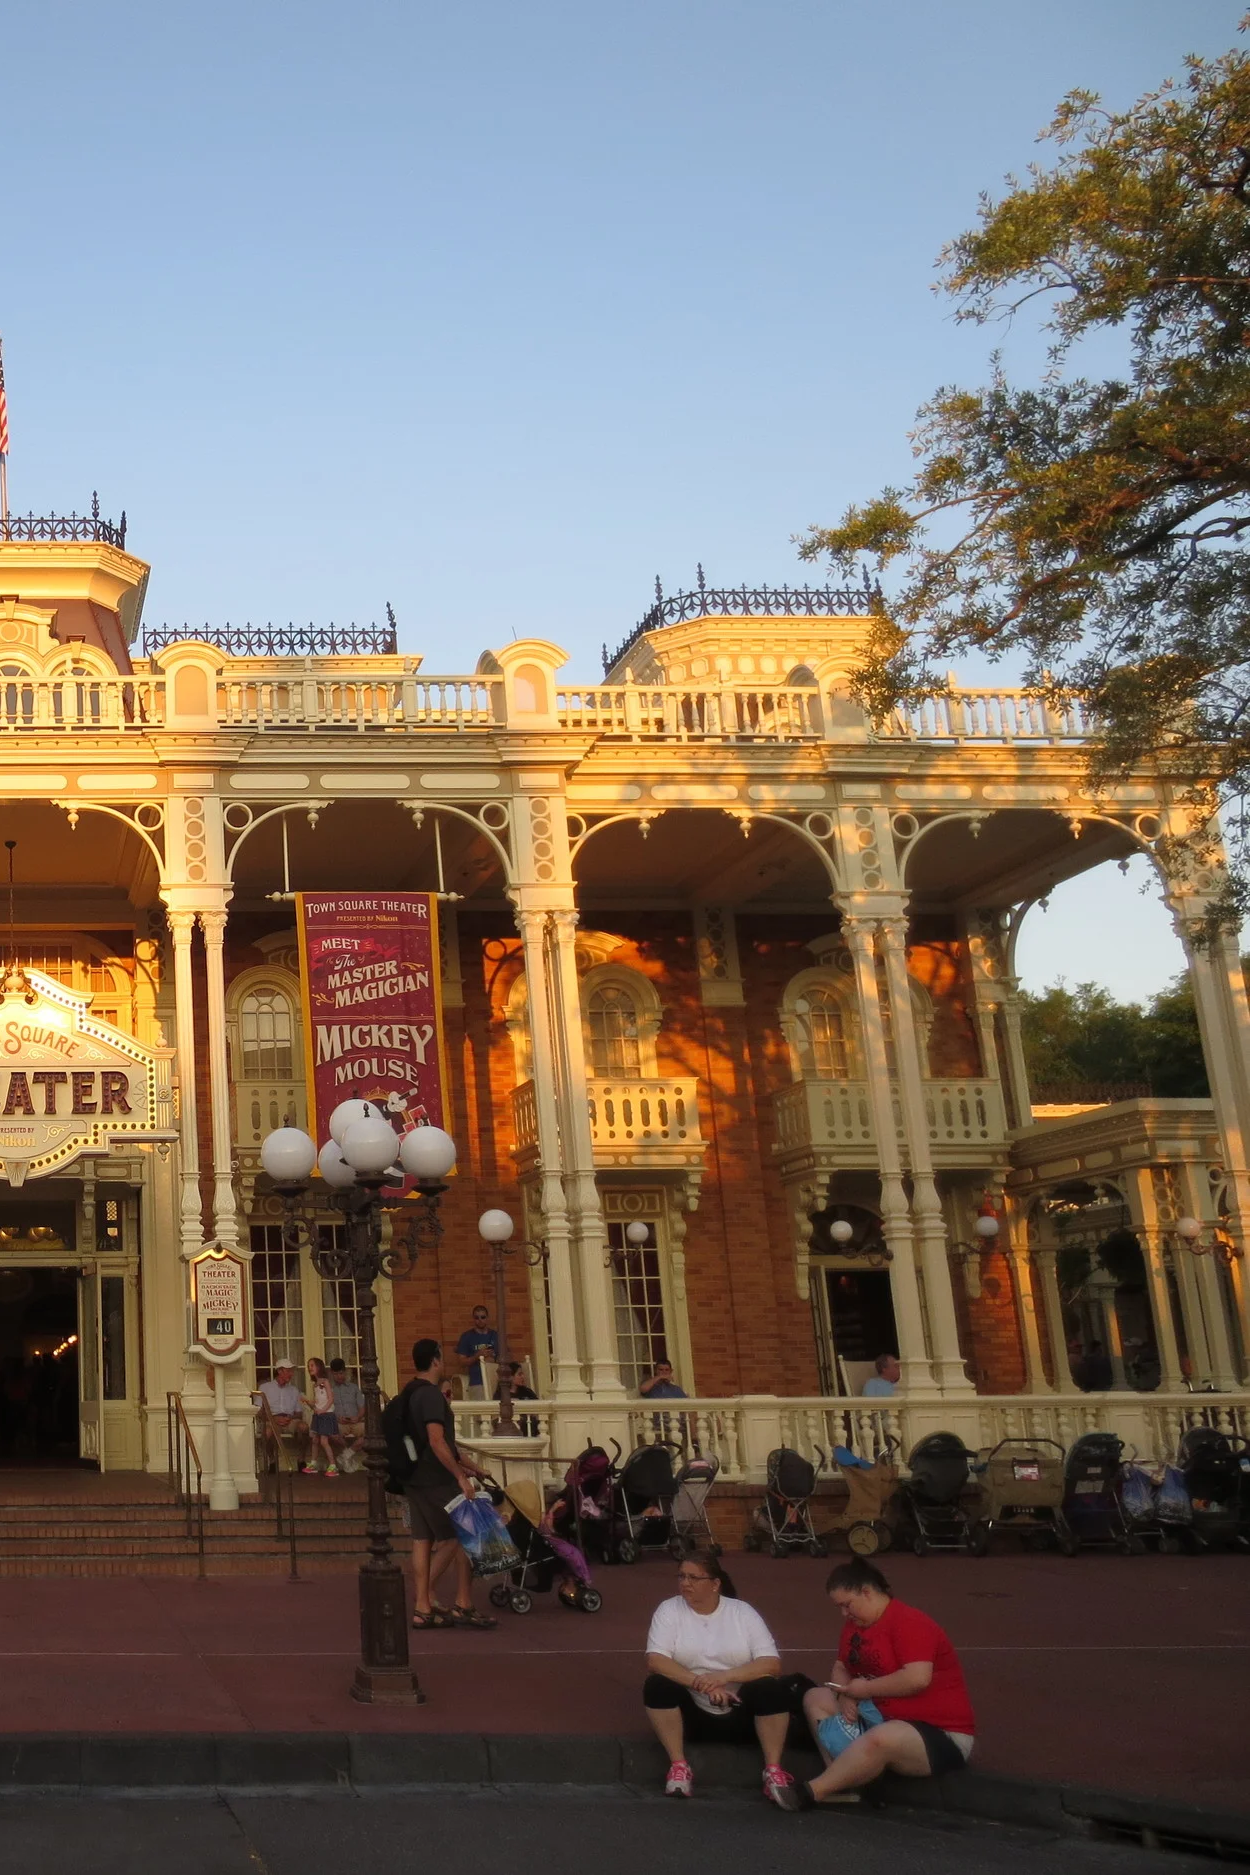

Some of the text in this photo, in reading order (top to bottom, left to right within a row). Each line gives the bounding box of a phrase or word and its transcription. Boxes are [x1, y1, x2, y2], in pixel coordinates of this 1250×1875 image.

[305, 900, 427, 919] TOWN SQUARE THEATER
[375, 914, 398, 922] Nikon
[321, 937, 361, 952] MEET
[333, 954, 356, 971] The
[327, 959, 398, 990] MASTER
[334, 970, 429, 1009] MAGICIAN
[3, 1021, 80, 1059] SQUARE
[315, 1024, 434, 1068] MICKEY
[334, 1057, 420, 1087] MOUSE
[202, 1270, 236, 1278] THEATER
[206, 1289, 233, 1297] MAGIC
[202, 1299, 239, 1311] MICKEY
[216, 1320, 232, 1333] 40
